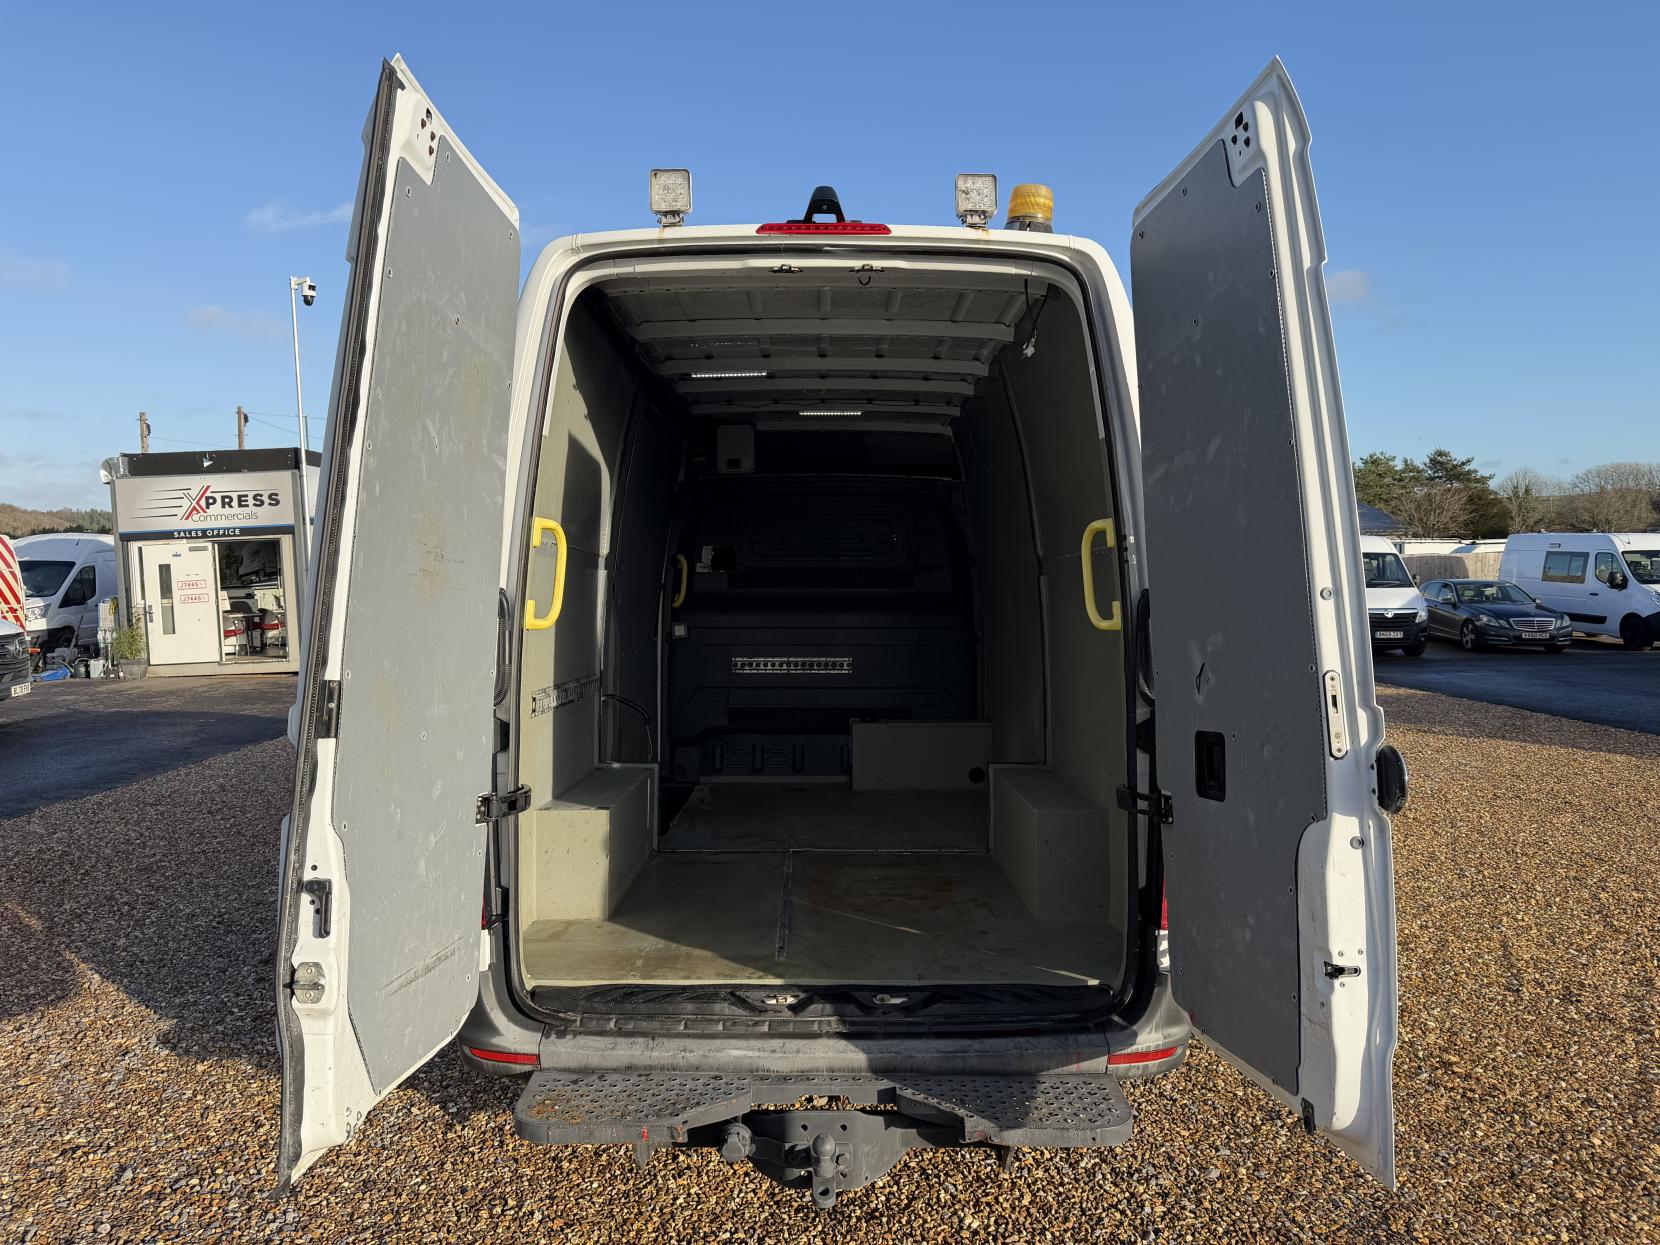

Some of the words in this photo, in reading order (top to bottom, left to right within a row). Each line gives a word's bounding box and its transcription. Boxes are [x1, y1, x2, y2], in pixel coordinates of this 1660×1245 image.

[180, 485, 281, 520] XPRESS
[191, 511, 259, 523] Commercials
[174, 530, 203, 538] SALES
[206, 528, 241, 536] OFFICE
